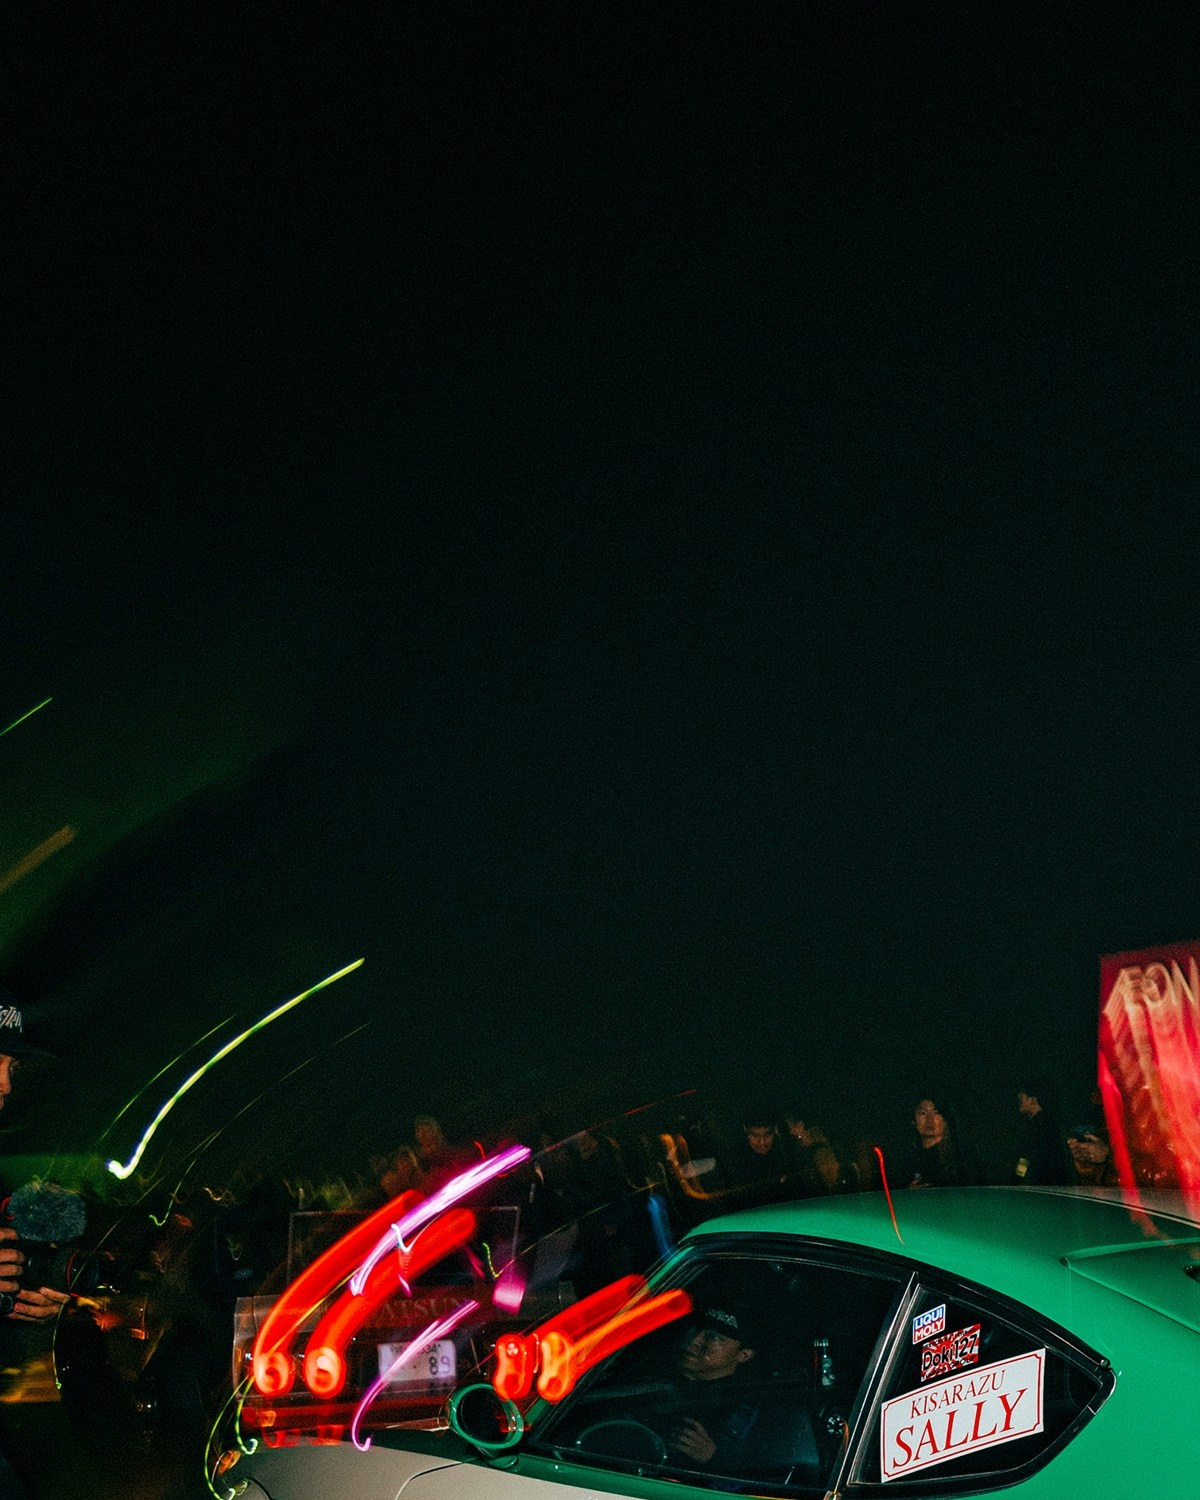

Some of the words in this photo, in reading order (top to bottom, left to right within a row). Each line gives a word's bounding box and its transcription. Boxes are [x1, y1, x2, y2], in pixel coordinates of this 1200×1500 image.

[914, 1307, 944, 1328] LIQUI
[914, 1320, 943, 1342] MOLY
[923, 1334, 978, 1371] Doki127
[910, 1370, 1006, 1418] KISARAZU
[892, 1388, 1027, 1469] SALLY
